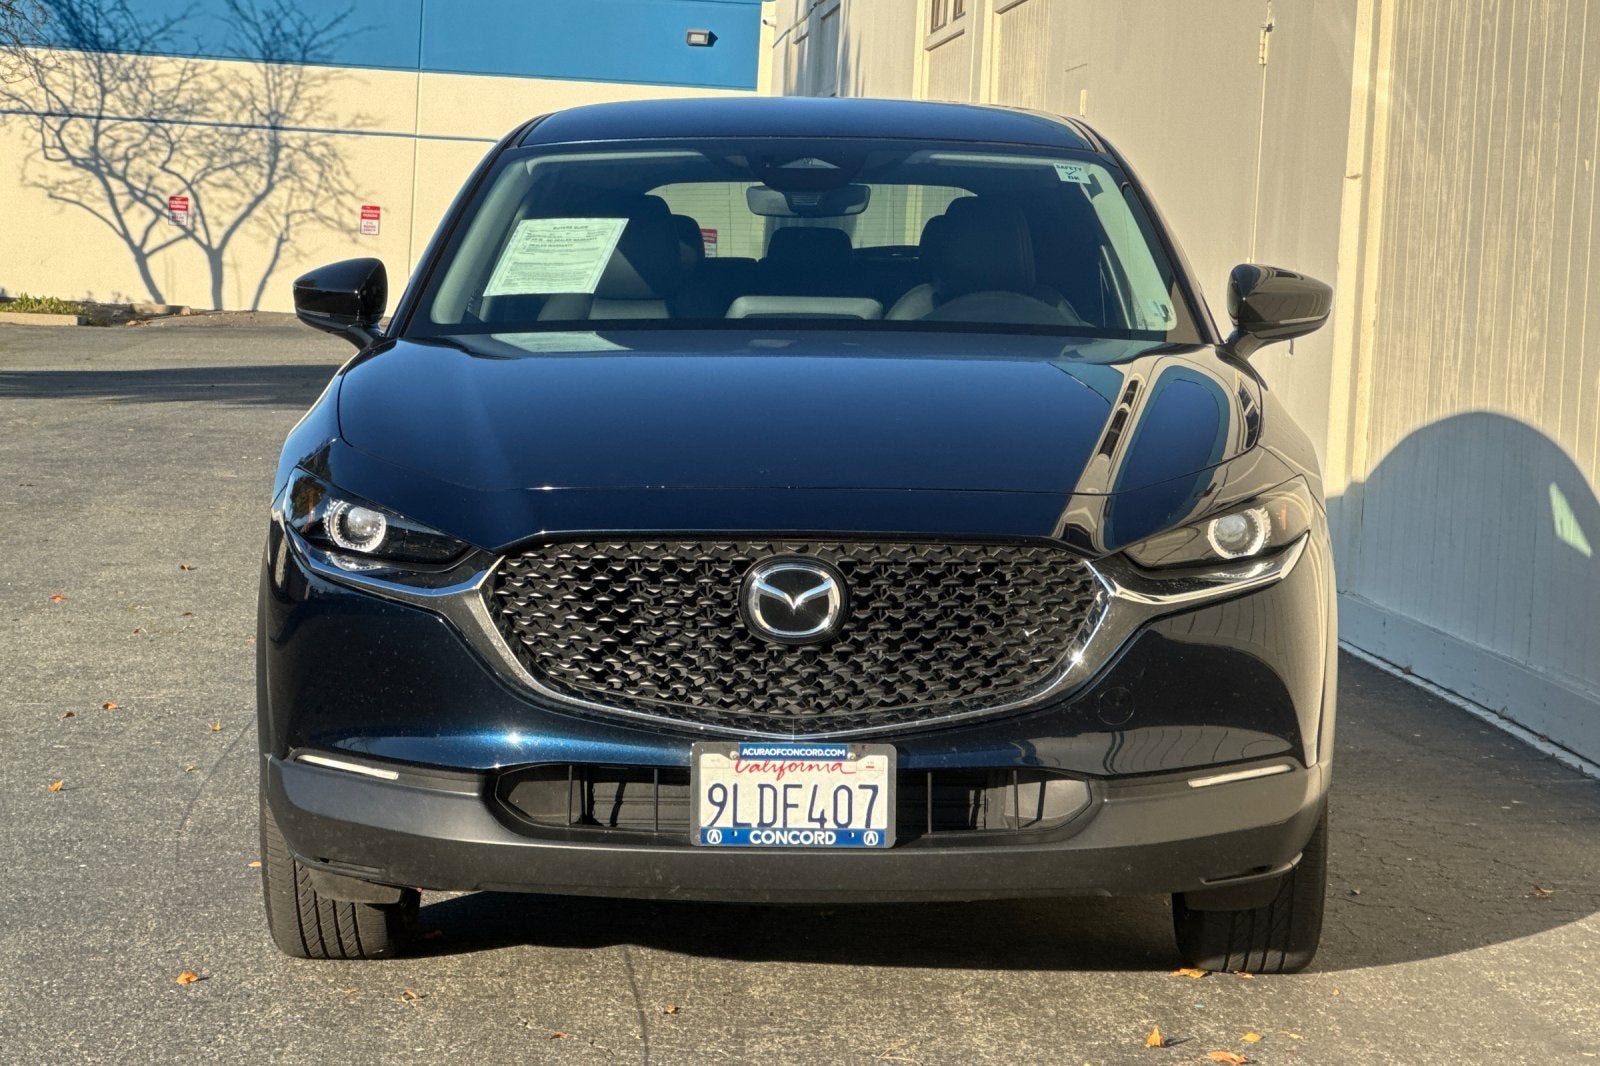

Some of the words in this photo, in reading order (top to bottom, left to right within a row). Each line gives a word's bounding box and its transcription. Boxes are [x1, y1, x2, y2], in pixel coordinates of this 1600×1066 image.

[741, 747, 846, 757] ACURAOFCONCORD.COM
[734, 759, 856, 781] California
[707, 783, 879, 829] 9LDF407
[749, 830, 836, 845] CONCORD
